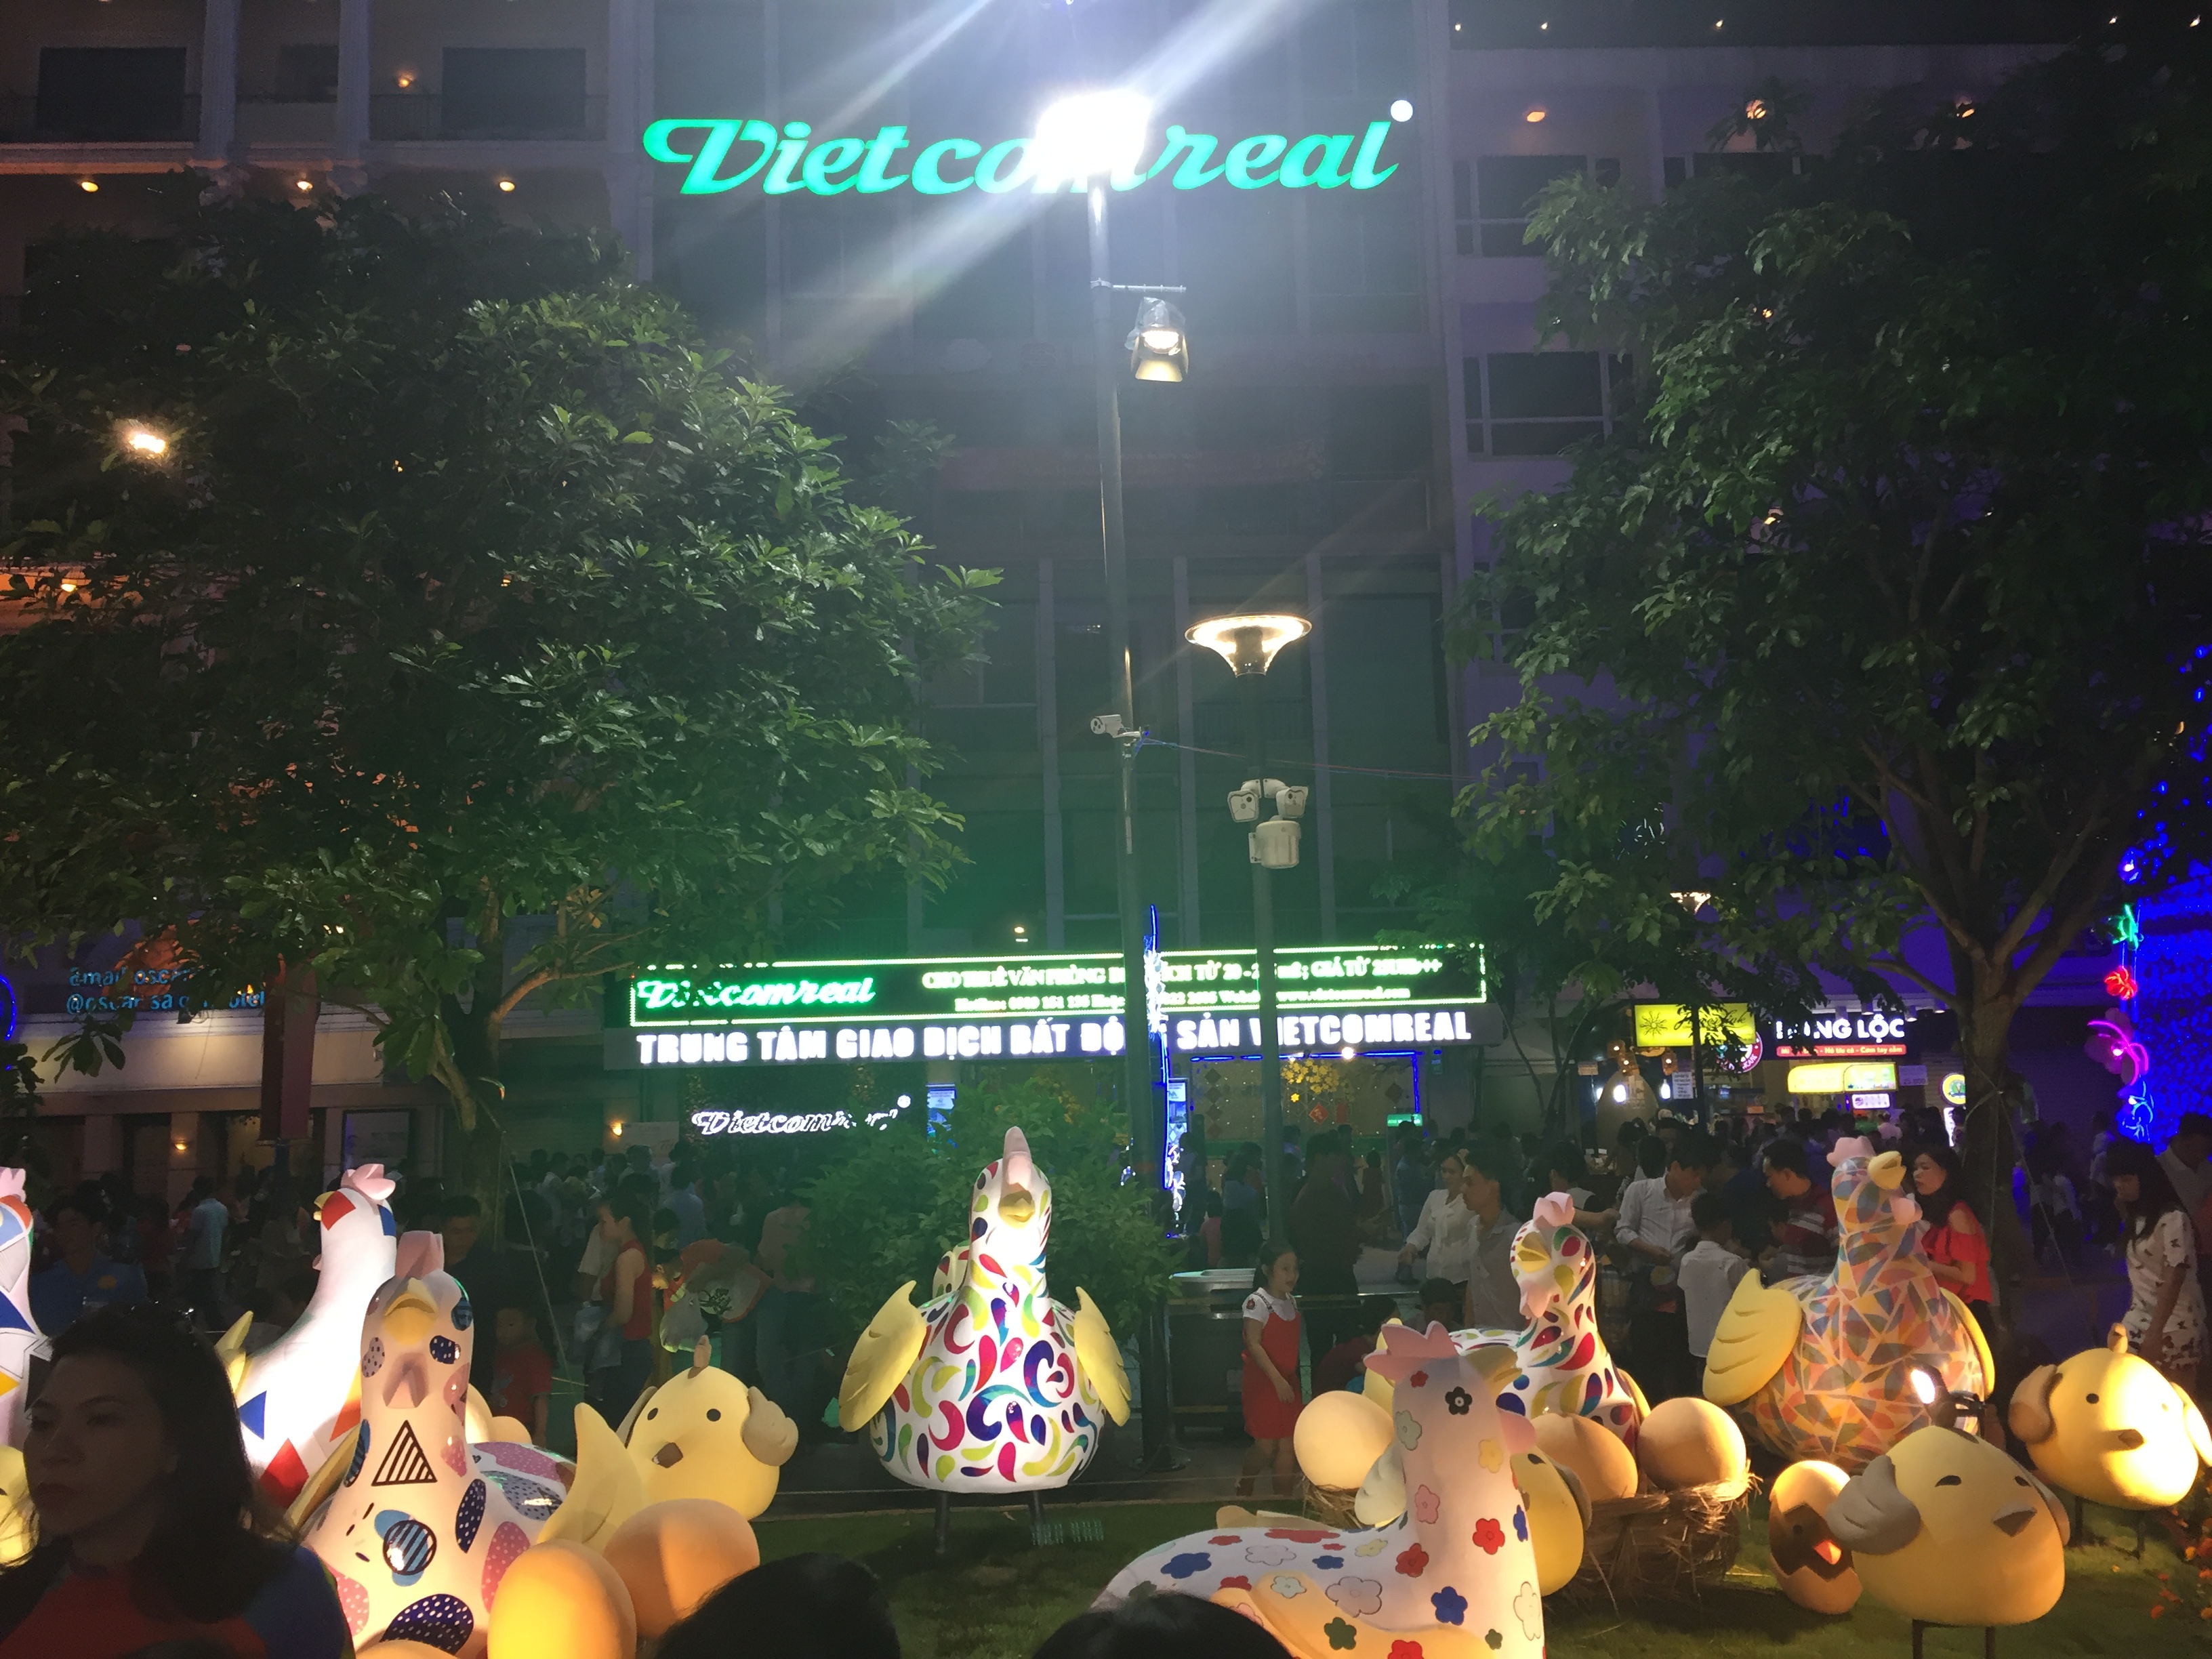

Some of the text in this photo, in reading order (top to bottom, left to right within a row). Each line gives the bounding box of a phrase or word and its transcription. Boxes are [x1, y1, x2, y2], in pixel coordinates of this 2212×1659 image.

[922, 971, 962, 989] CHO
[1008, 966, 1046, 985] VĂN
[1046, 964, 1107, 985] PHÒNG
[637, 977, 876, 1008] Vicomreal
[636, 1031, 748, 1063] TRUNG
[756, 1025, 827, 1061] TÂM
[835, 1027, 914, 1059] GIAO
[923, 1024, 1002, 1061] DỊCH
[1010, 1016, 1071, 1055] BẤT
[1080, 1015, 1126, 1056] ĐỘ
[1176, 1012, 1241, 1050] SẢN
[1857, 1013, 1906, 1044] LỘC
